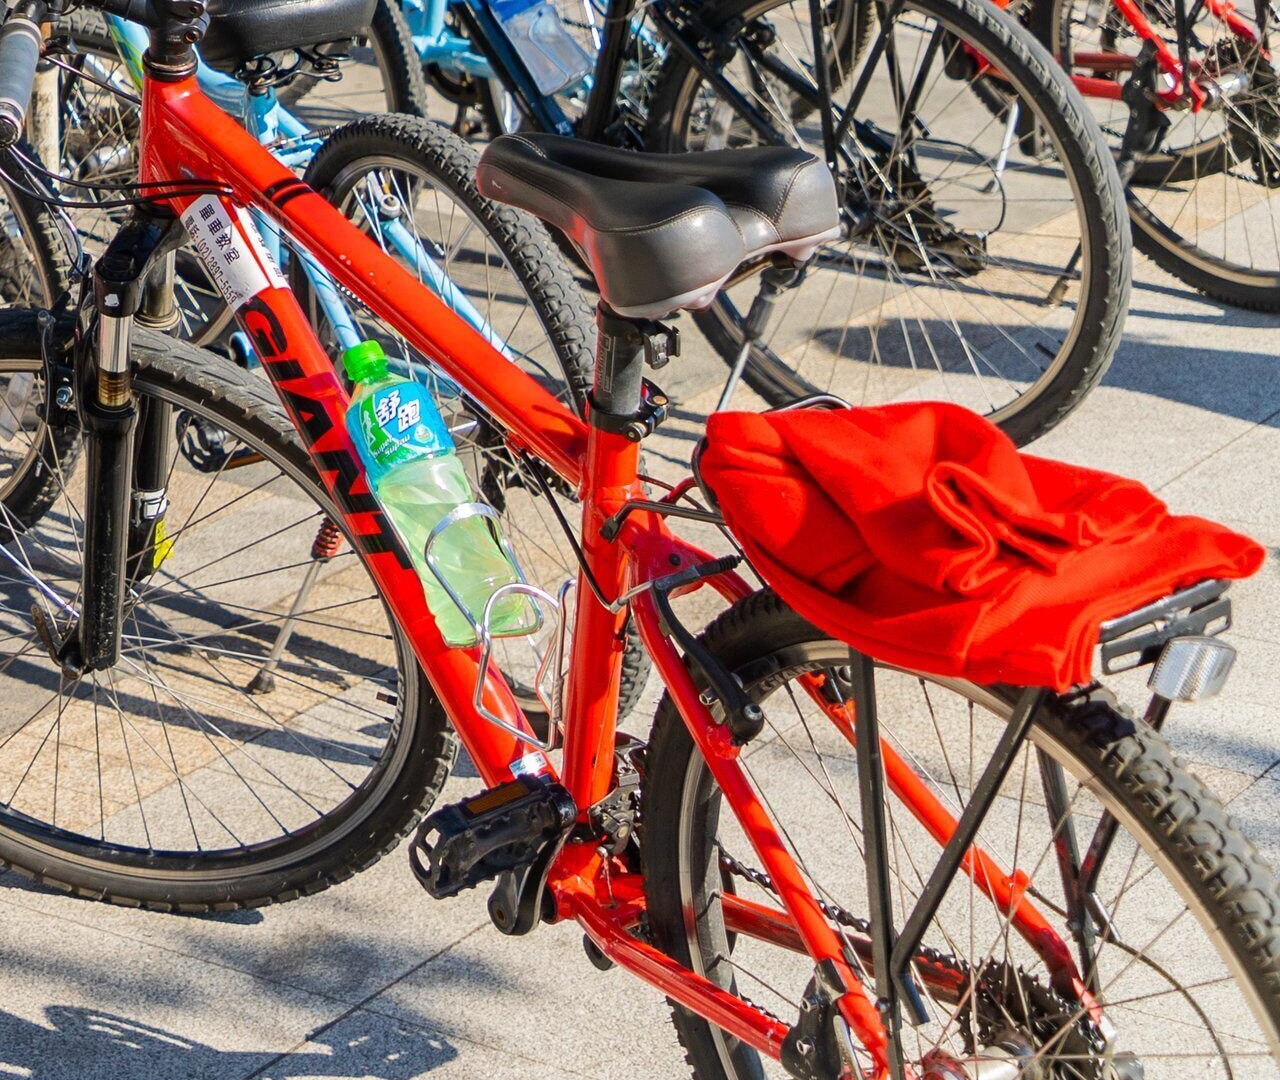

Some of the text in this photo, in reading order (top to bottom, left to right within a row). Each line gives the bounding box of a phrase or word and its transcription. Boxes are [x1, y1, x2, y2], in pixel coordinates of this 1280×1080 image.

[198, 203, 240, 265] 單車教室
[241, 294, 415, 570] GIANT
[375, 389, 421, 435] 舒跑
